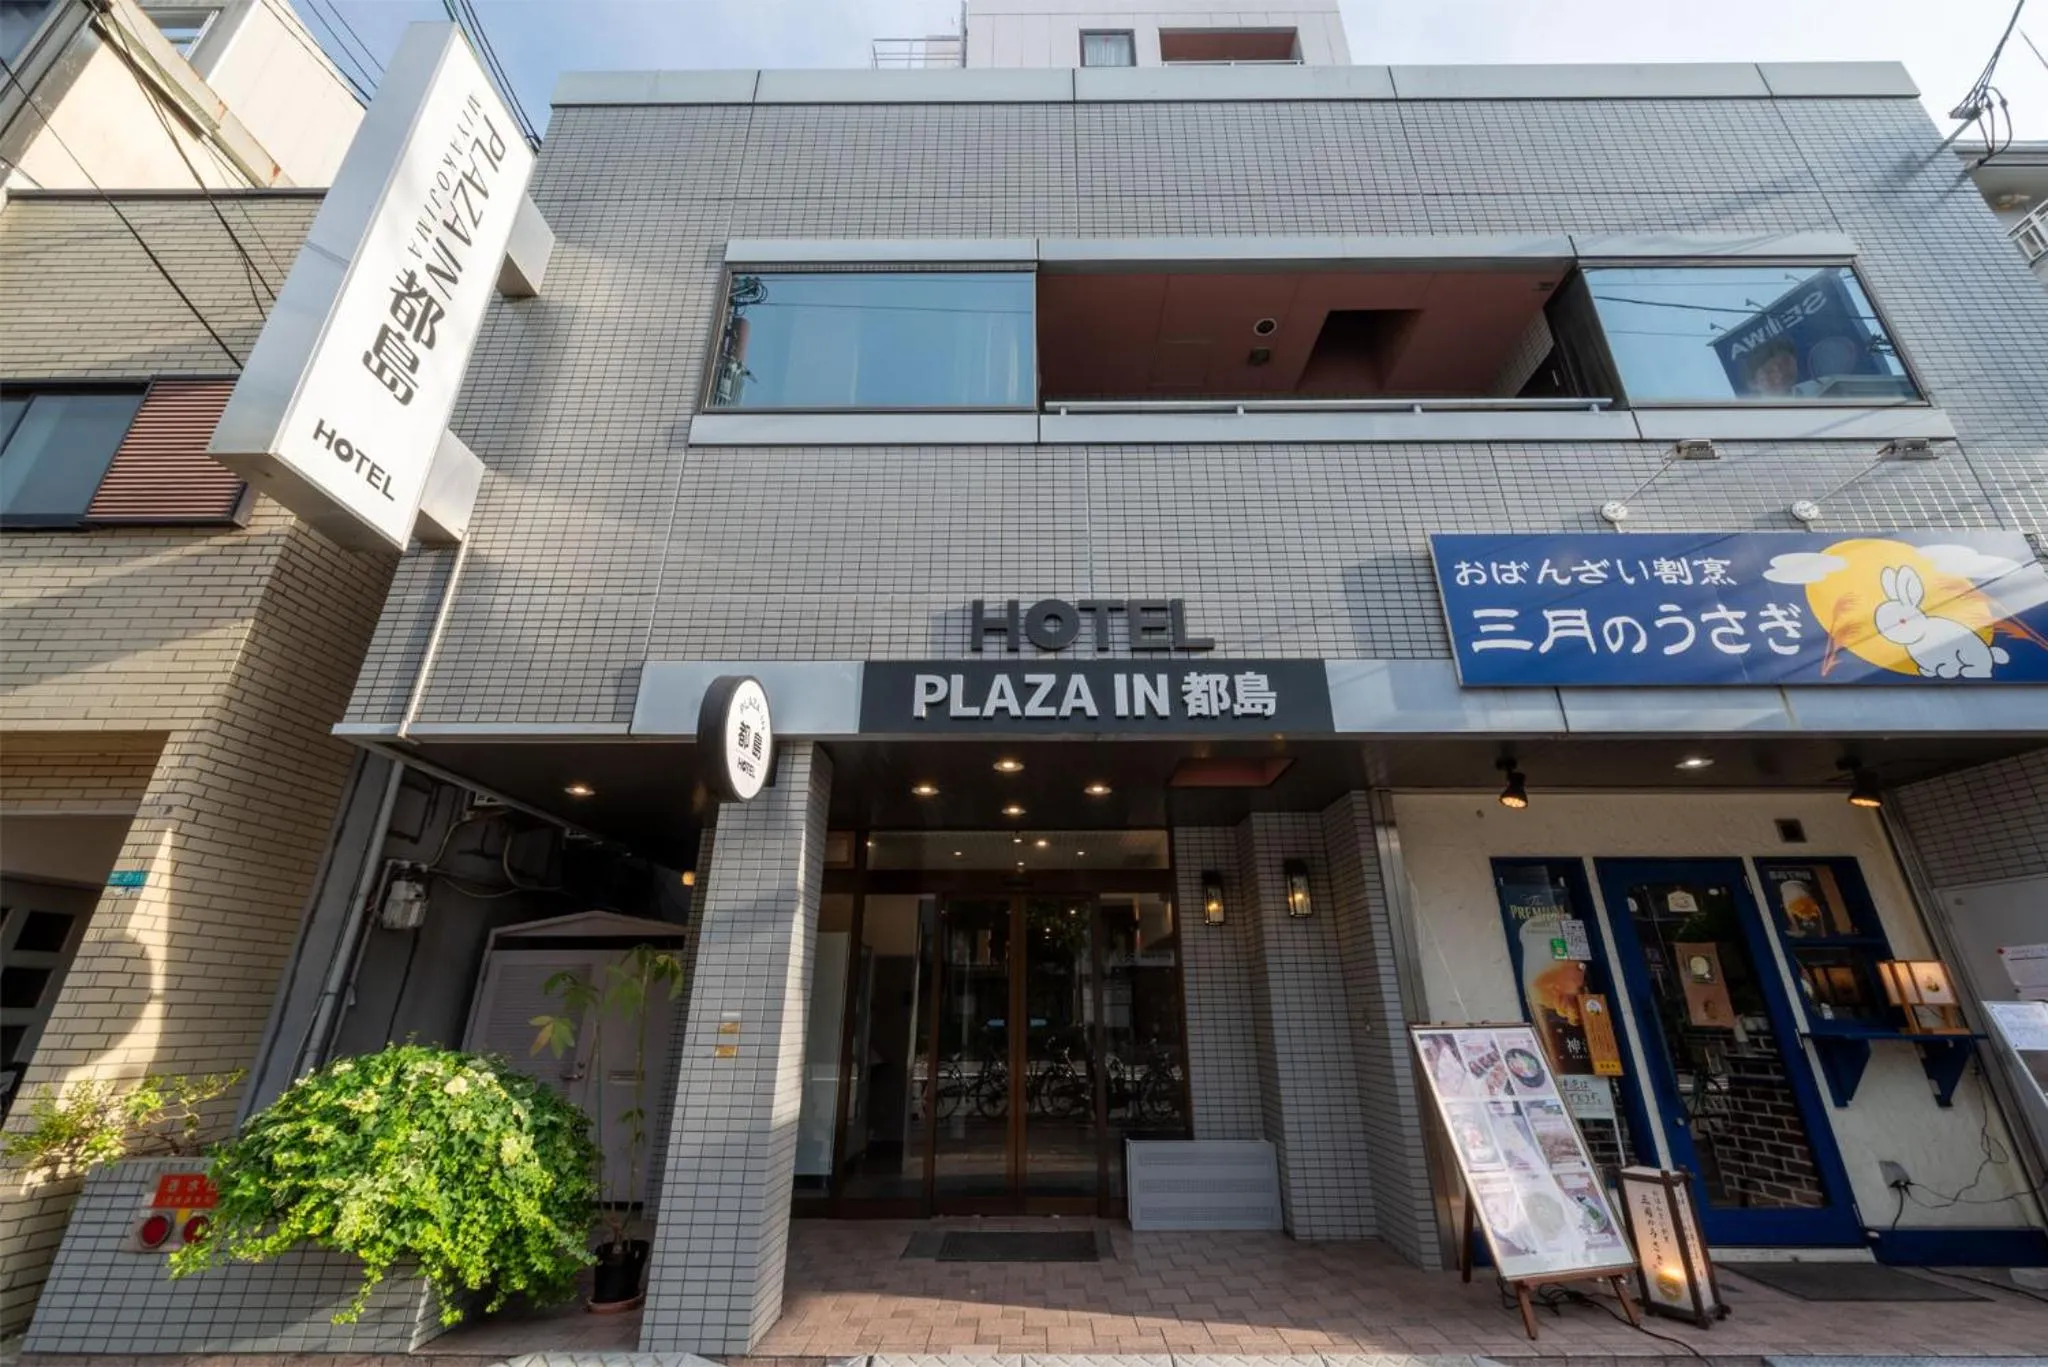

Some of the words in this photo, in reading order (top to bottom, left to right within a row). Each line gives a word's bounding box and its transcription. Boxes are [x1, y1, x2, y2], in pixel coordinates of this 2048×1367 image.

[407, 94, 481, 259] MIYAKOJIMA
[442, 114, 506, 247] PLAZA
[424, 236, 463, 301] IN
[362, 267, 446, 406] 都島
[312, 418, 396, 502] HOTEL
[1453, 557, 1738, 587] おばんざい割烹
[971, 599, 1215, 652] HOTEL
[1471, 603, 1803, 656] 三月のうさぎ
[913, 673, 1099, 719] PLAZA
[1113, 673, 1170, 719] IN
[1181, 671, 1278, 719] 都島
